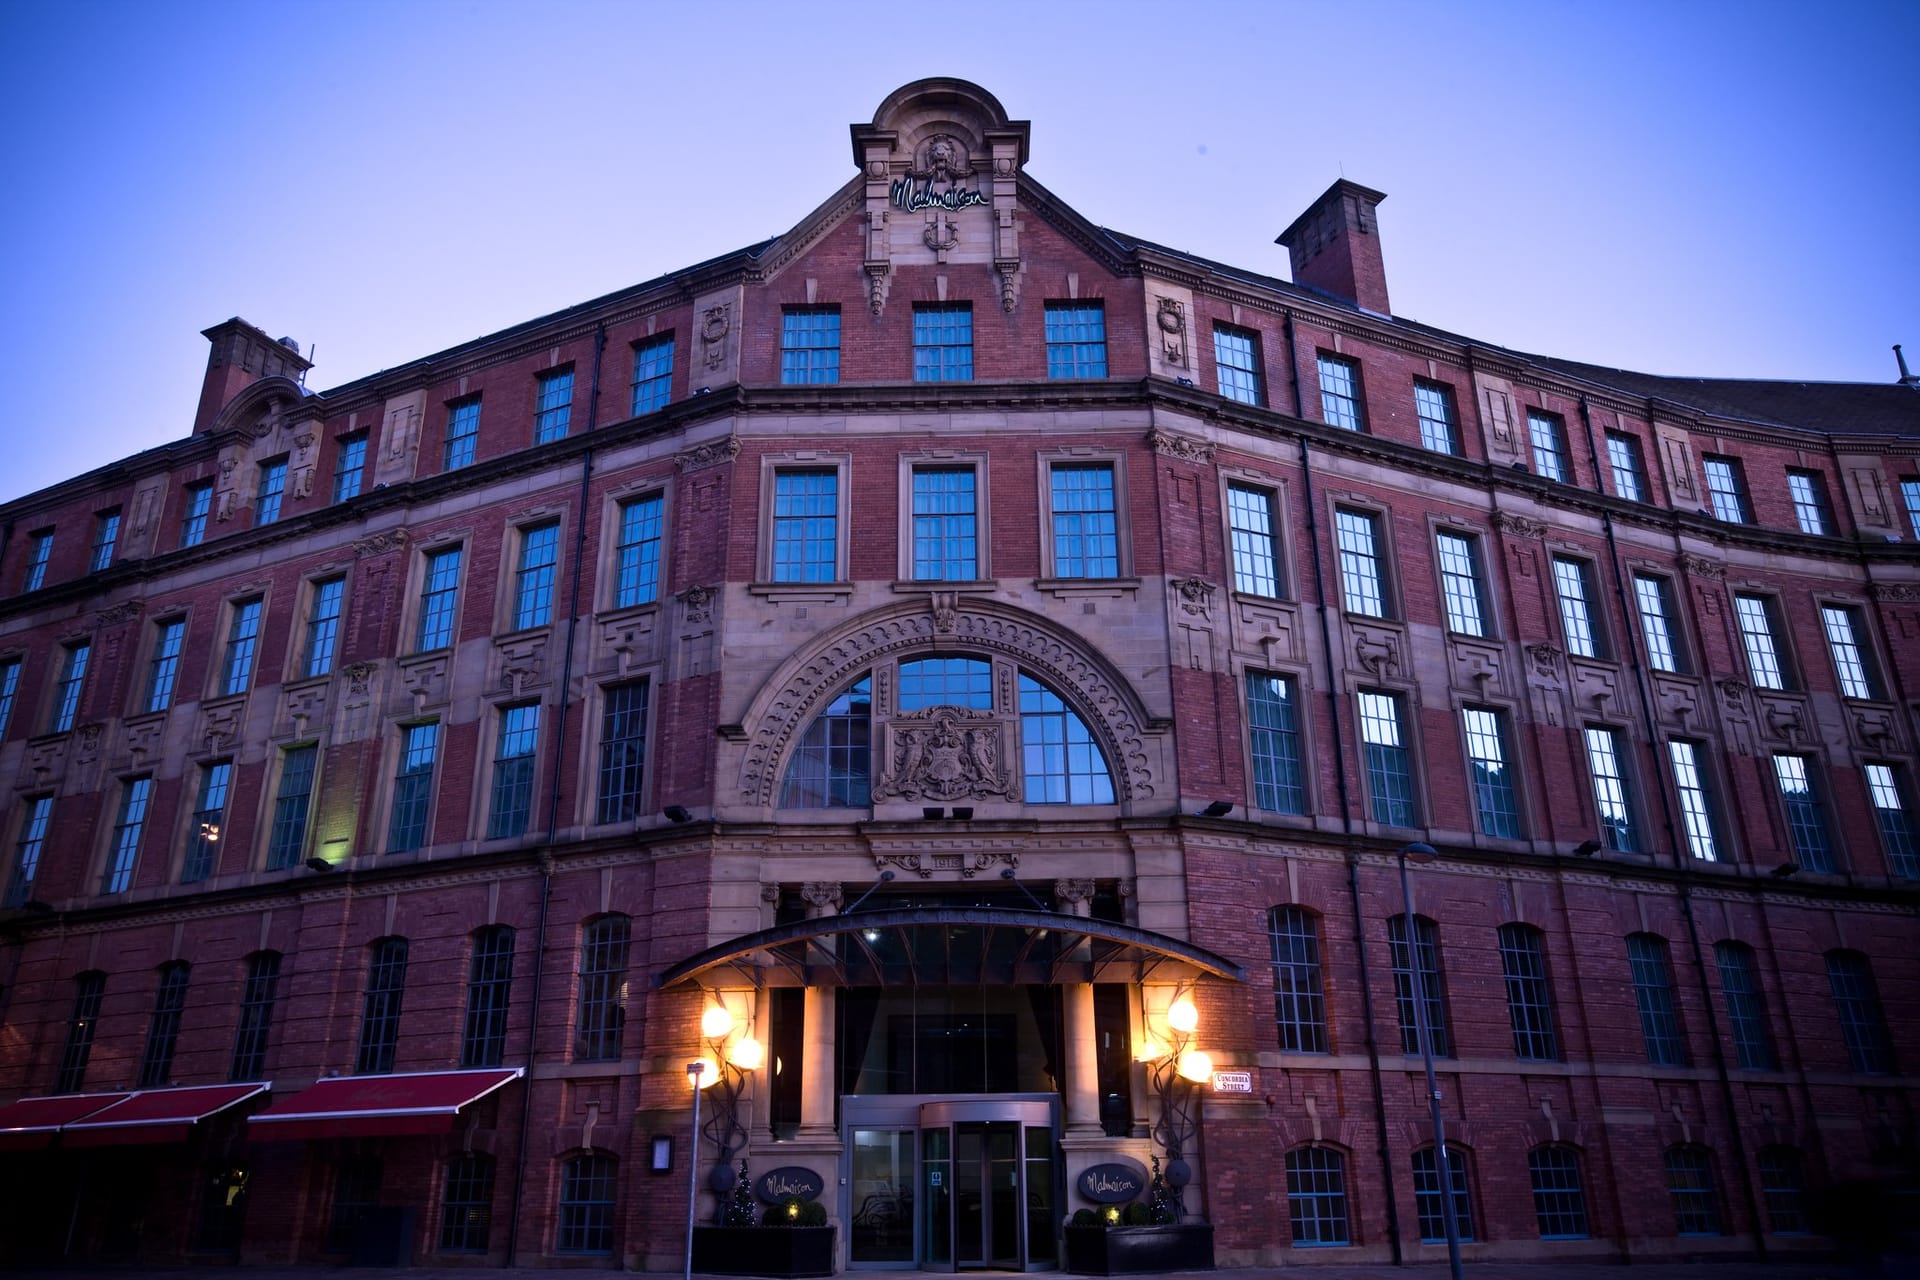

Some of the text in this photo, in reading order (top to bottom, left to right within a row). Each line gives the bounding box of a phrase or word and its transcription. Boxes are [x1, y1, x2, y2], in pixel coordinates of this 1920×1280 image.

[891, 175, 990, 213] Malmaison
[766, 1175, 814, 1196] Malmaison
[1087, 1172, 1136, 1194] Malmaison
